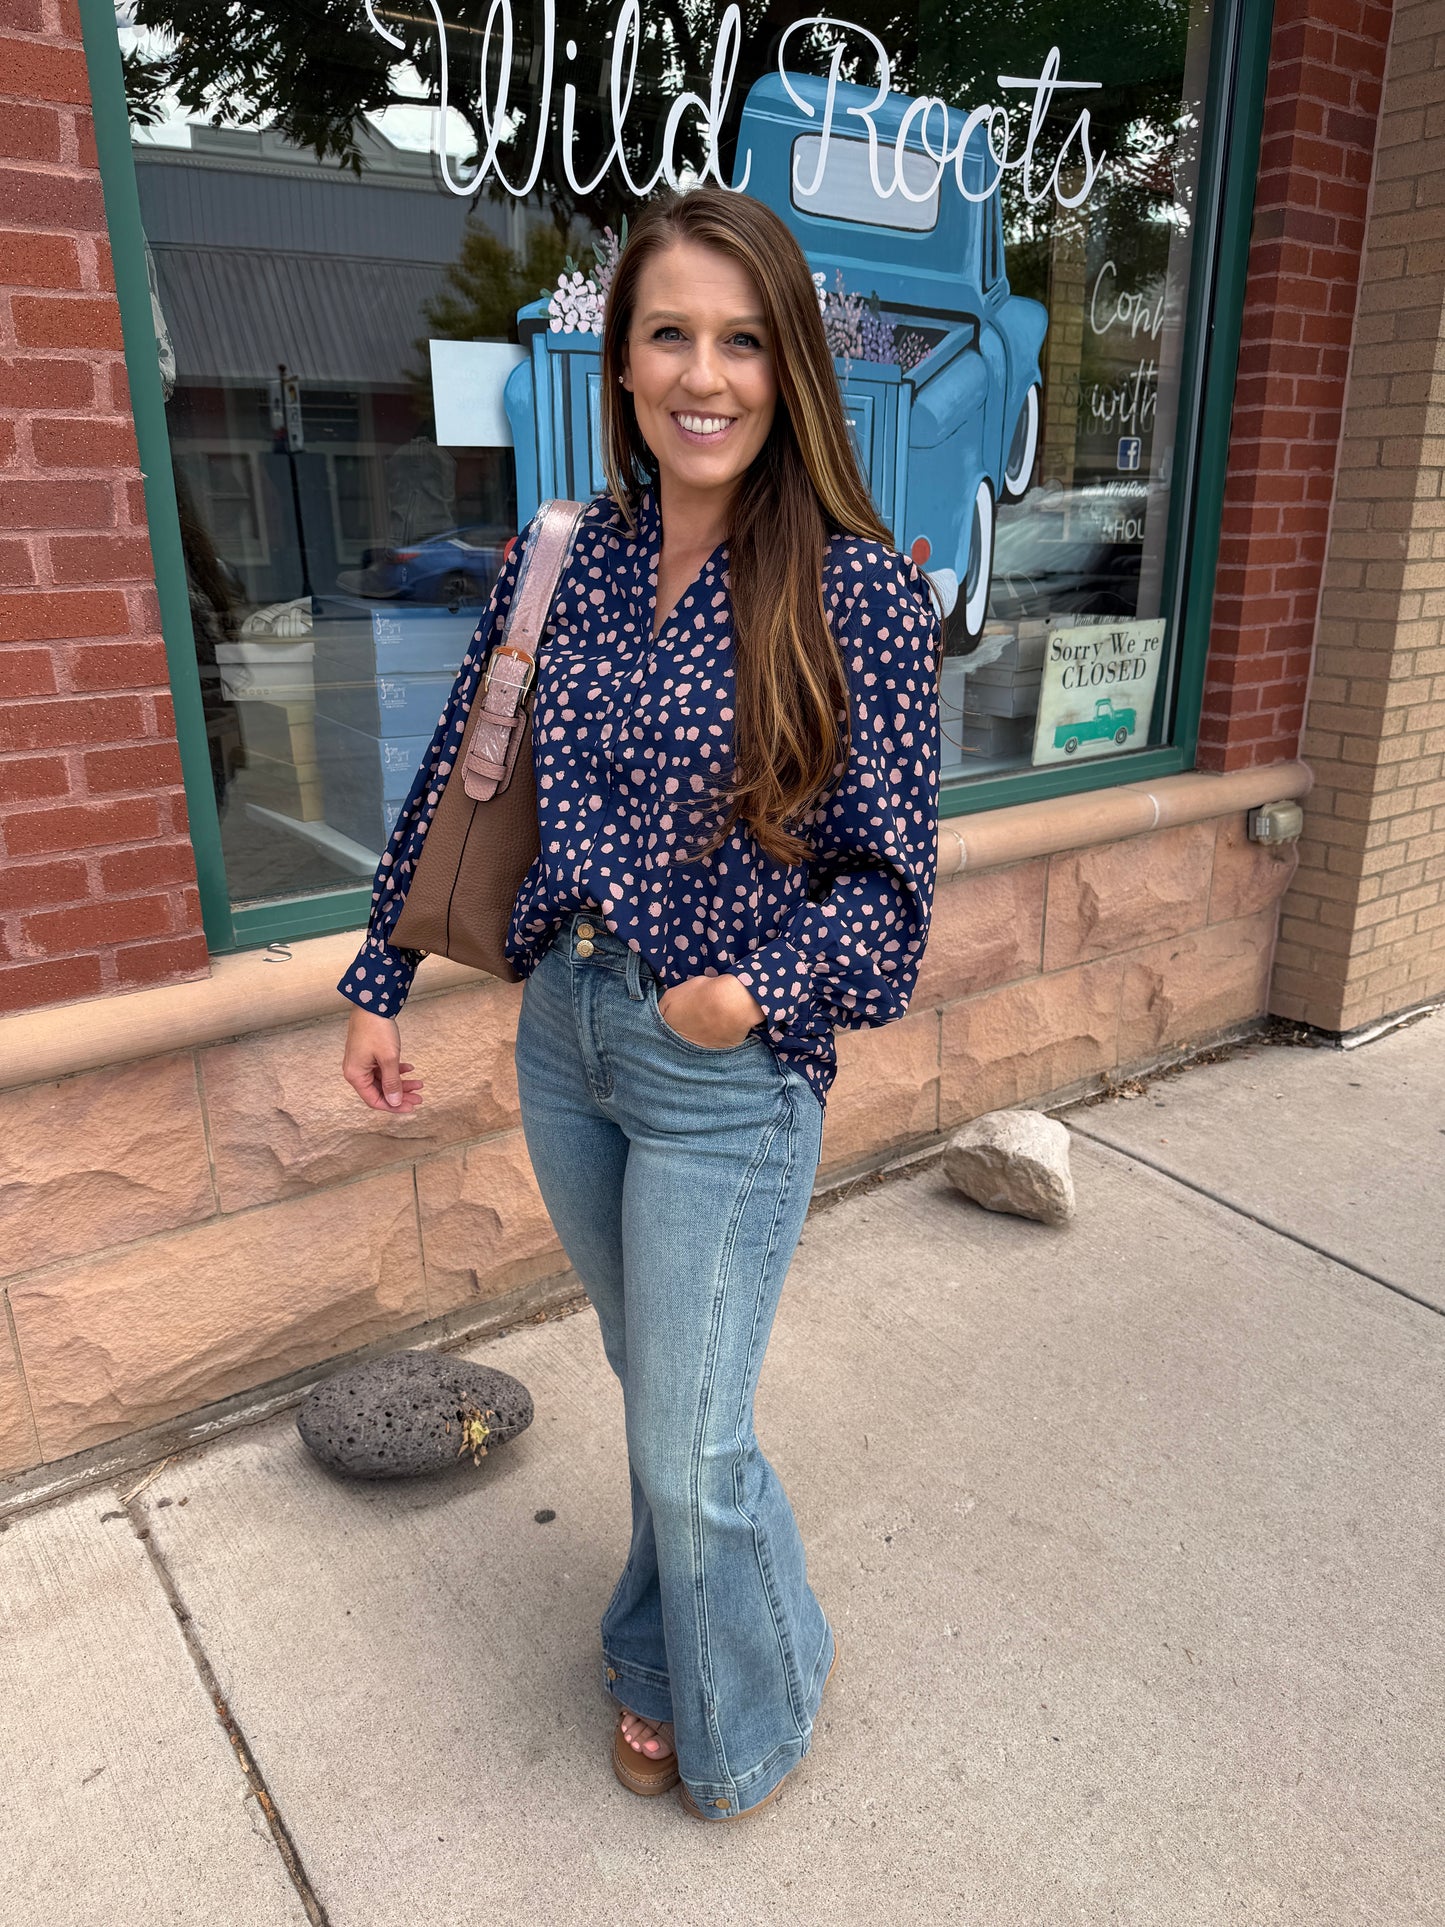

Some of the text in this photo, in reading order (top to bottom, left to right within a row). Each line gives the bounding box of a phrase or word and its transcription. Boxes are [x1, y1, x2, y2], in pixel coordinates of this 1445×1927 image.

[366, 0, 1107, 208] Wild Roots
[1050, 637, 1104, 665] Sorry
[1062, 658, 1147, 690] CLOSED
